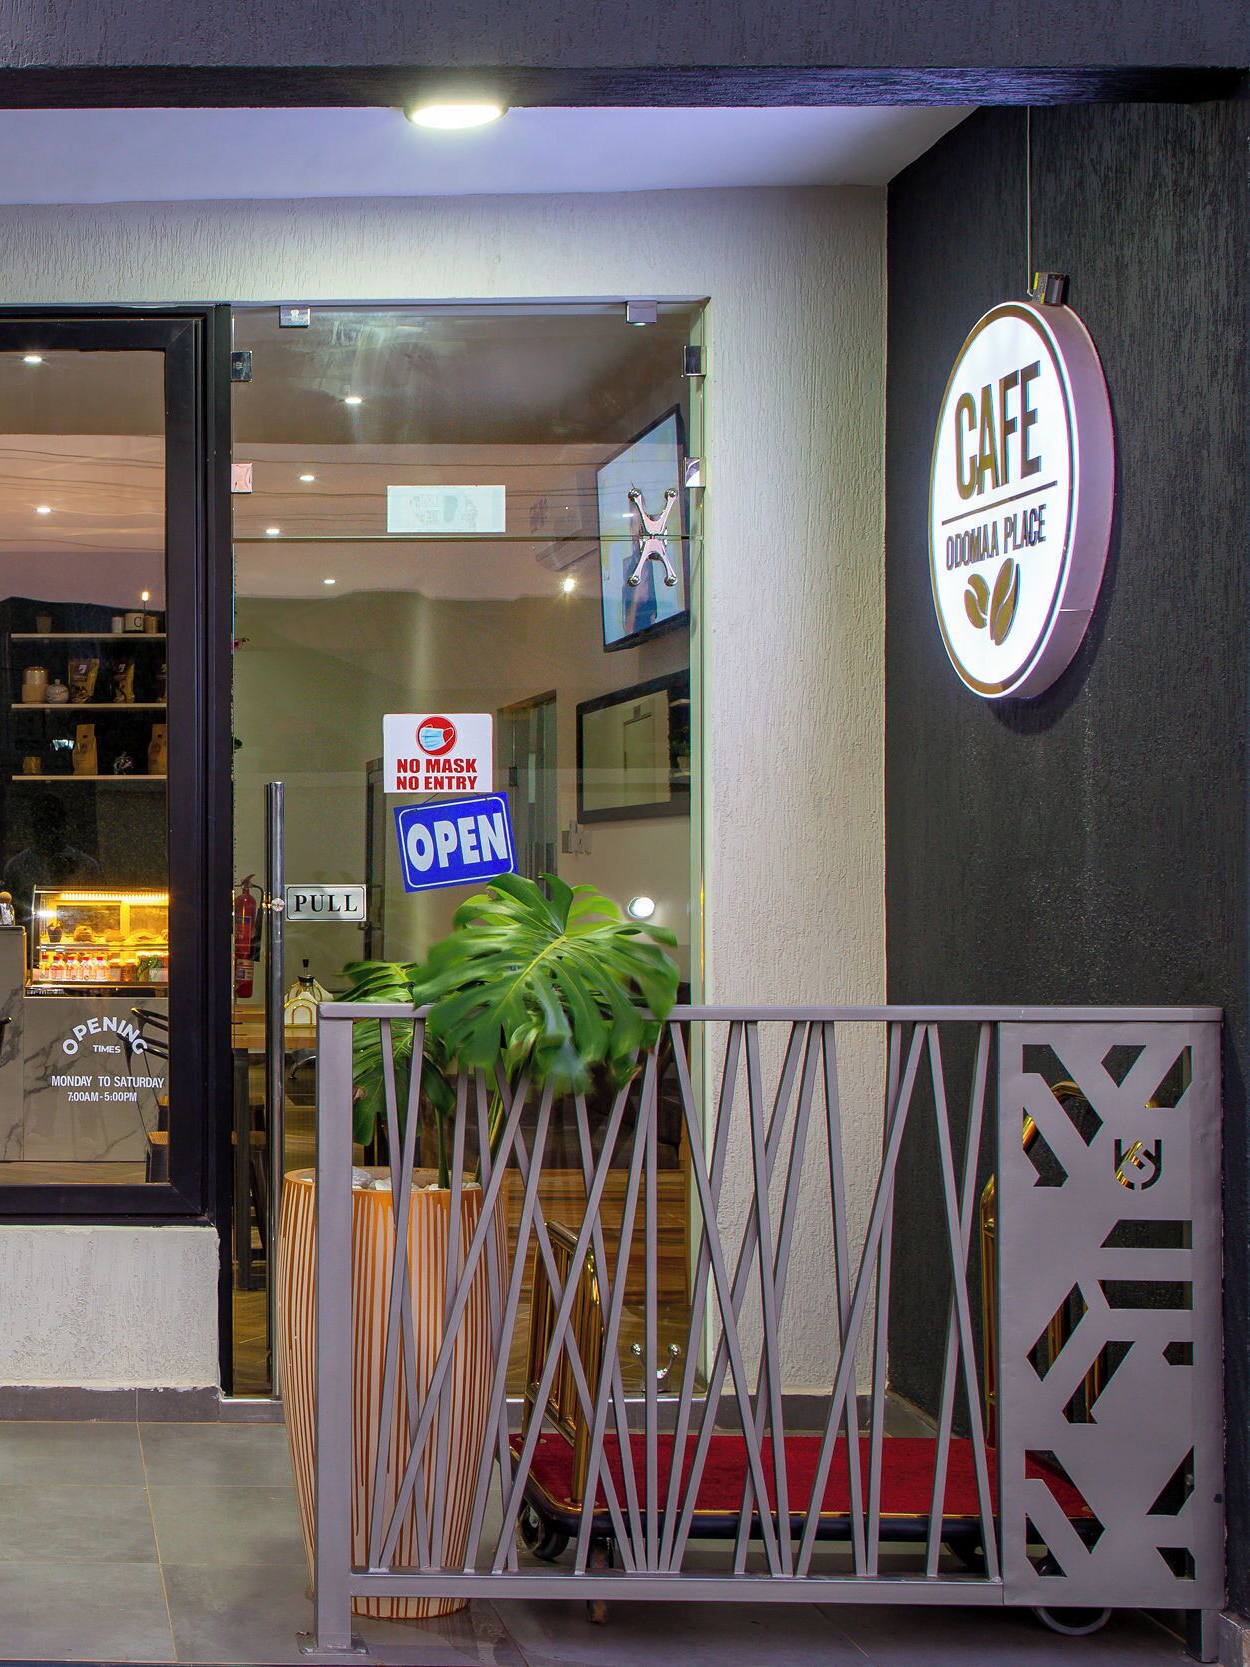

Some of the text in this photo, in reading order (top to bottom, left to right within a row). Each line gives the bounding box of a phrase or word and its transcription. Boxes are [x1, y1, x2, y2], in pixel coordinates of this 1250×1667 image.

[955, 360, 1041, 500] CAFE
[946, 504, 1047, 570] ODOMAA PLACE
[397, 758, 478, 773] NO MASK
[396, 776, 478, 790] NO ENTRY
[407, 812, 508, 872] OPEN
[294, 894, 358, 912] PULL
[62, 1016, 148, 1055] OPENING
[92, 1044, 121, 1054] TIMES
[51, 1075, 164, 1088] MONDAY TO SATURDAY
